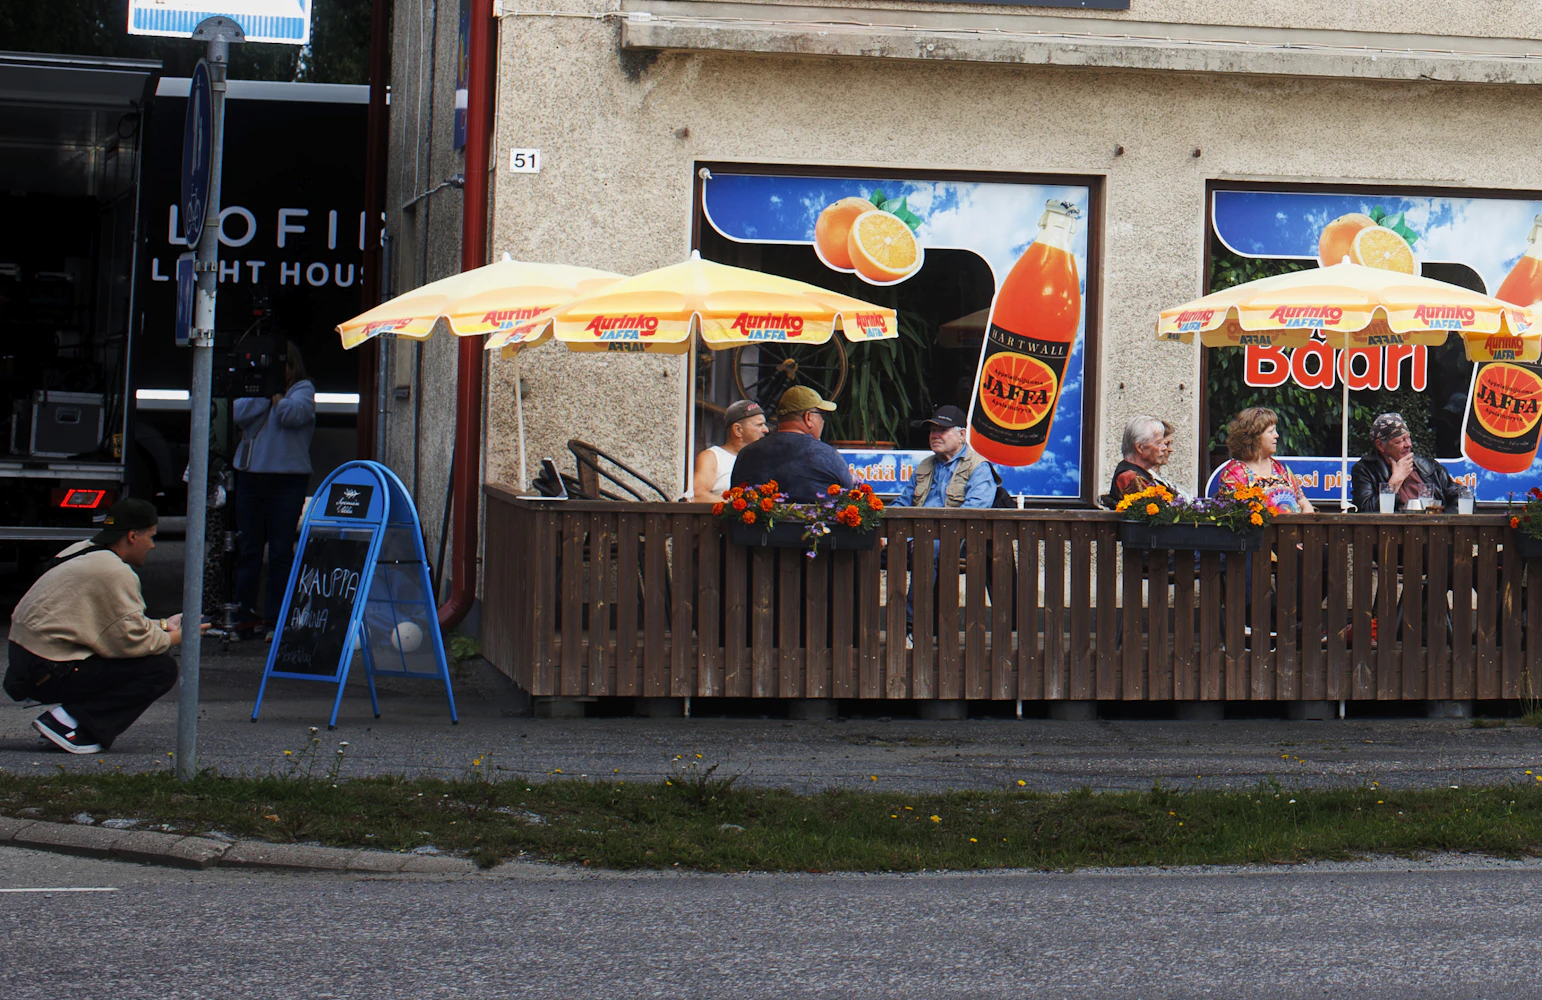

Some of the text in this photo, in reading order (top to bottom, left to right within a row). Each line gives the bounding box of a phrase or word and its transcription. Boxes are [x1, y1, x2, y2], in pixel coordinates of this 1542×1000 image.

[514, 153, 535, 168] 51
[152, 258, 364, 287] LHT HOU
[481, 307, 552, 326] Aurink
[584, 312, 659, 337] Aurinko
[731, 312, 804, 337] Aurinko
[855, 311, 888, 334] Aurinko
[1173, 309, 1215, 328] Aurinko
[1269, 304, 1343, 326] Aurinko
[1285, 318, 1324, 328] JAFFA
[1413, 304, 1475, 326] Aurinko
[1428, 319, 1463, 330] JAFFA
[600, 328, 639, 340] JAFFA
[748, 328, 787, 340] JAFFA
[991, 329, 1065, 356] HARTWALL
[1484, 335, 1524, 356] Aurinko
[1493, 349, 1515, 360] JAFFA
[983, 373, 1049, 406] JAFFA
[1477, 384, 1539, 414] JAFFA
[297, 564, 359, 604] KAUPPA
